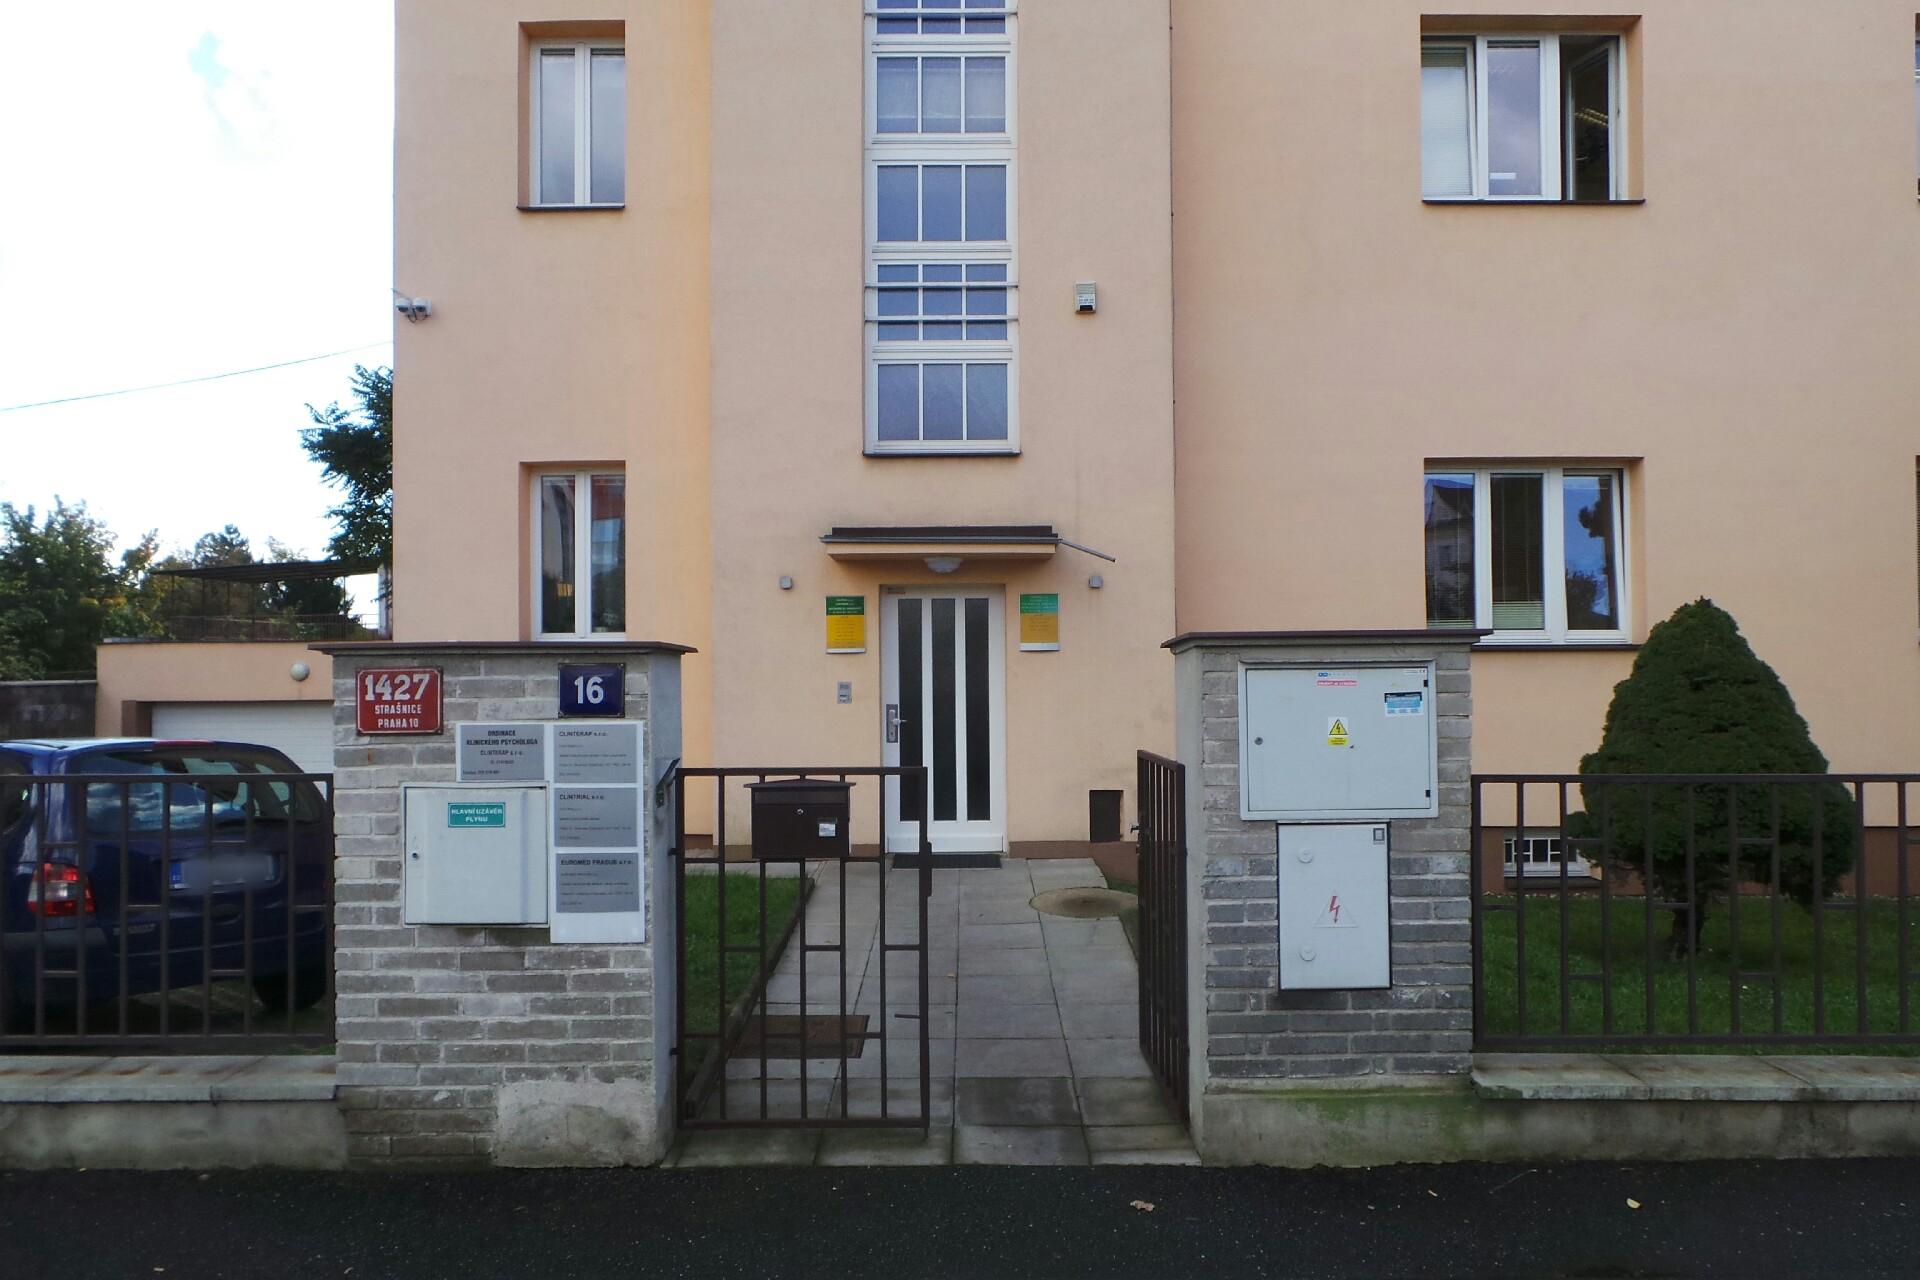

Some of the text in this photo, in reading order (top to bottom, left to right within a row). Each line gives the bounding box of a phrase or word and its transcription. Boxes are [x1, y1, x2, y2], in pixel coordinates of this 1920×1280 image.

[365, 673, 430, 701] 1427
[574, 676, 604, 704] 16
[375, 702, 422, 714] STRAŠNICE
[378, 718, 419, 728] PRAHA 10
[501, 738, 538, 746] PSYCHOLOGA
[451, 807, 475, 815] HLAVNÍ
